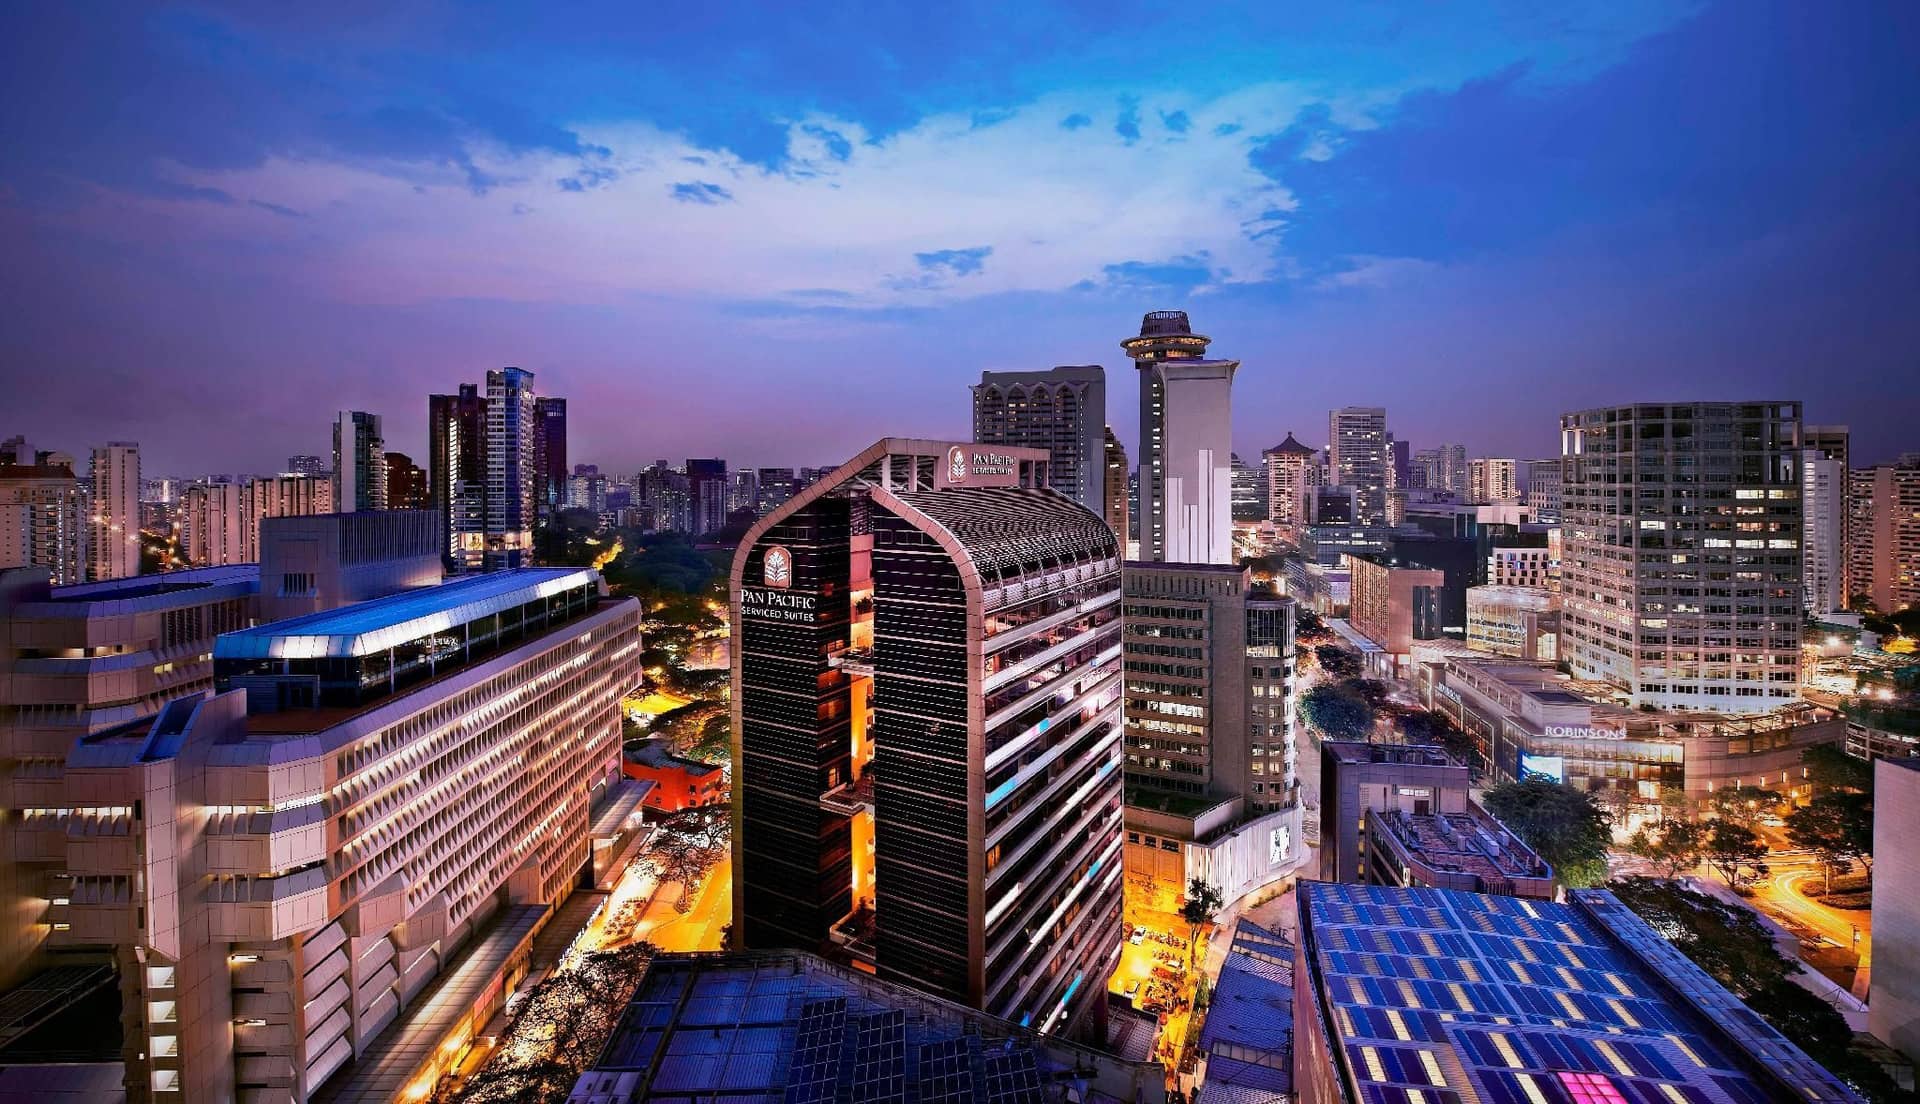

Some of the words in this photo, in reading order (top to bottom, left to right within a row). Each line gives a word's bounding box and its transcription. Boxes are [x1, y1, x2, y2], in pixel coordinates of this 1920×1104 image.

[973, 453, 988, 465] PAN
[741, 589, 764, 604] PAN
[768, 591, 816, 609] PACIFIC
[741, 606, 782, 618] SERVICED
[784, 610, 815, 622] SUITES
[1545, 726, 1627, 739] ROBINSONS
